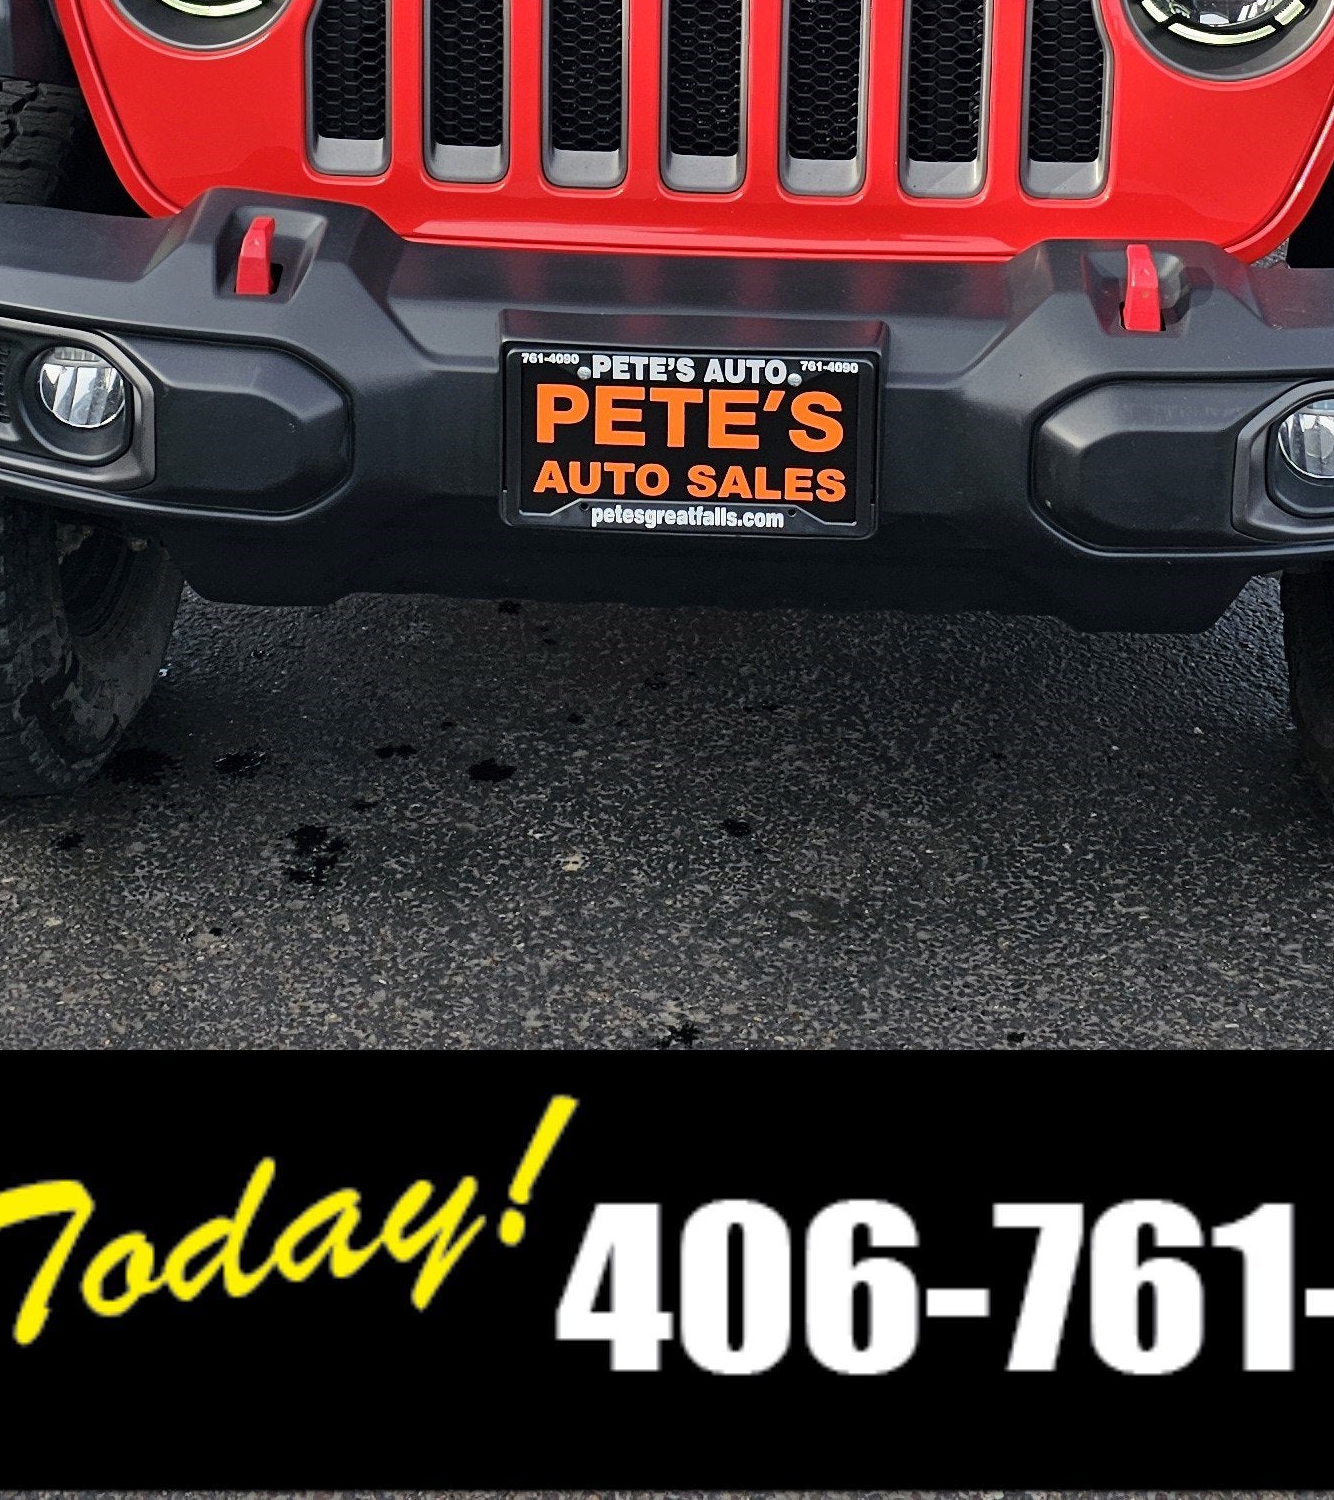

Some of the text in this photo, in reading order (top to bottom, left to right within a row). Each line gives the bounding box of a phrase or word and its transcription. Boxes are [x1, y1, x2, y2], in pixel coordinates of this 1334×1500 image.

[520, 352, 580, 365] 761-4090
[591, 354, 788, 385] PETE'S AUTO
[799, 360, 859, 374] 761-4090
[536, 383, 844, 453] PETE'S
[533, 460, 847, 502] AUTO SALES
[590, 505, 785, 529] petesgreatfalls.com
